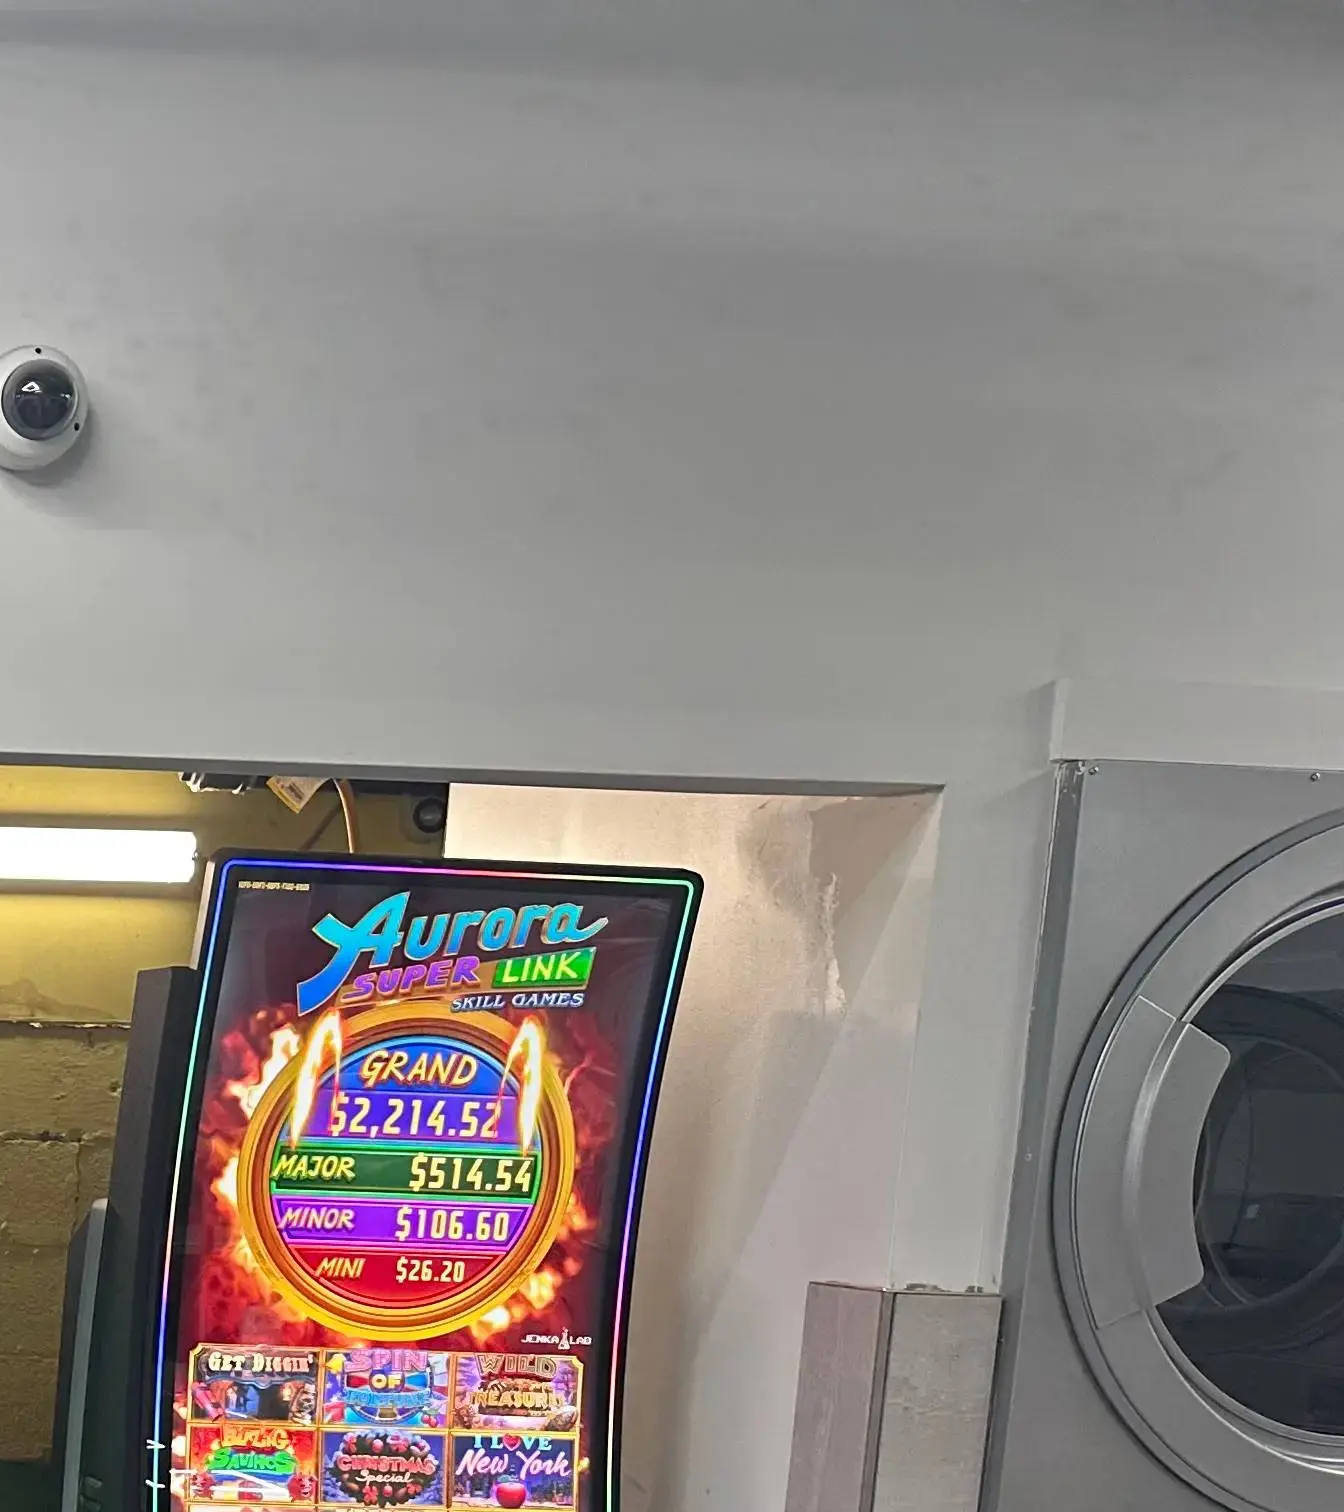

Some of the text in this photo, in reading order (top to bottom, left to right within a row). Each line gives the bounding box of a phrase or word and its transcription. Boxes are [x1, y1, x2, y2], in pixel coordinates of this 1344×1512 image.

[297, 891, 609, 1016] Aurora
[352, 954, 581, 998] SUPER LINK
[451, 992, 585, 1012] SKILL GAMES
[360, 1051, 477, 1087] GRAND
[330, 1091, 502, 1139] $2,214.52
[272, 1152, 533, 1193] MAJOR $514.54
[278, 1206, 510, 1242] MINOR $106.60
[315, 1257, 466, 1283] MINI $26.20
[208, 1351, 245, 1372] GET
[346, 1349, 429, 1373] SPIN
[475, 1353, 557, 1378] WILD
[371, 1375, 403, 1389] OF
[336, 1454, 436, 1476] CHRISTMAS
[355, 1468, 412, 1484] Special
[455, 1449, 572, 1480] New York
